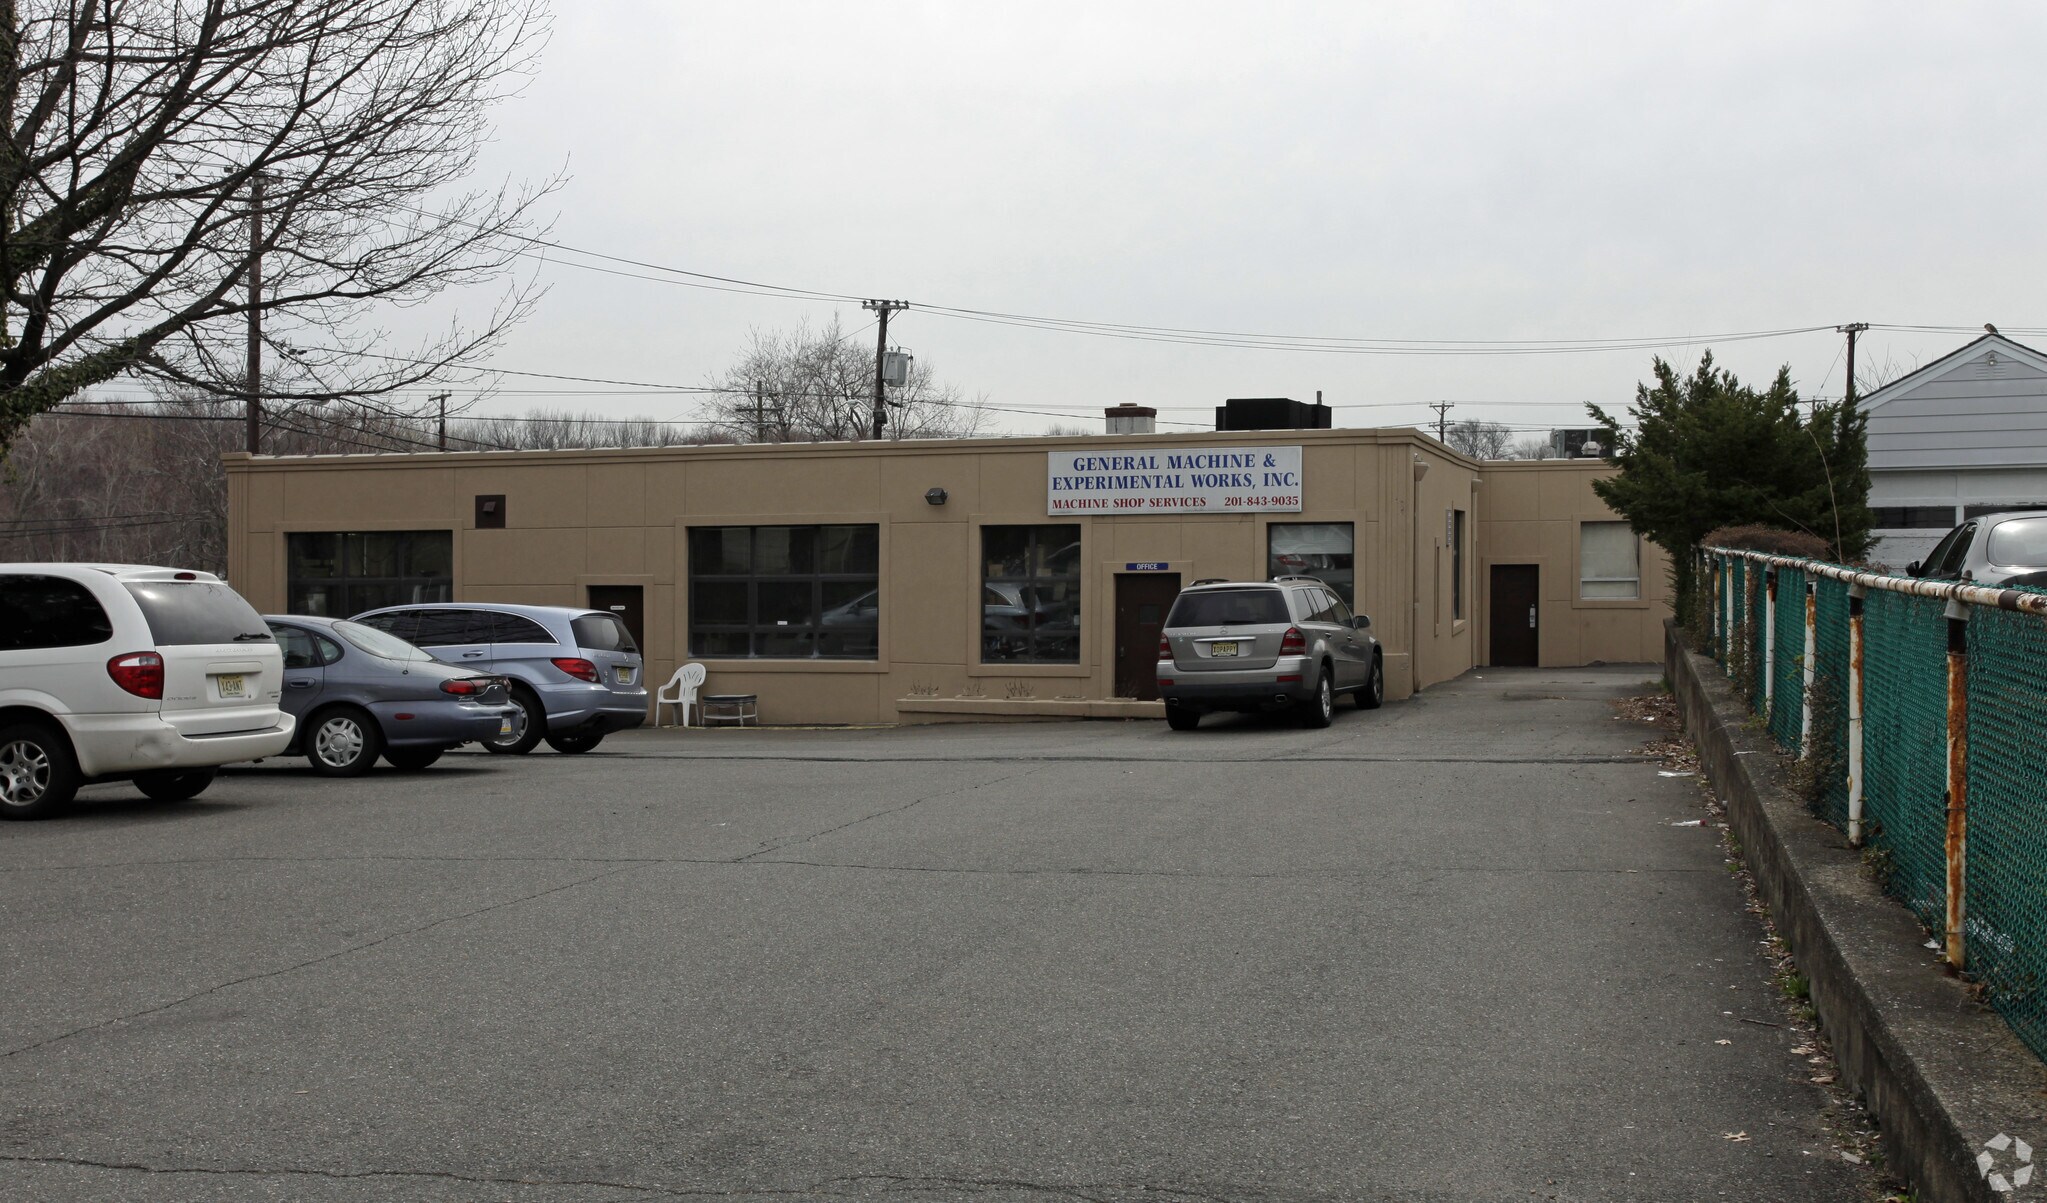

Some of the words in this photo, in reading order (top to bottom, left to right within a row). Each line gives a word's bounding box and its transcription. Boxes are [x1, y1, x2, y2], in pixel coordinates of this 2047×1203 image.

[1073, 456, 1160, 472] GENERAL
[1167, 454, 1256, 470] MACHINE
[1263, 453, 1277, 468] &
[1052, 474, 1185, 491] EXPERIMENTAL
[1191, 473, 1257, 490] WORKS,
[1263, 472, 1299, 487] INC.
[1052, 498, 1109, 509] MACHINE
[1113, 497, 1145, 509] SHOP
[1149, 496, 1207, 508] SERVICES
[1224, 495, 1299, 507] 201-843-9035
